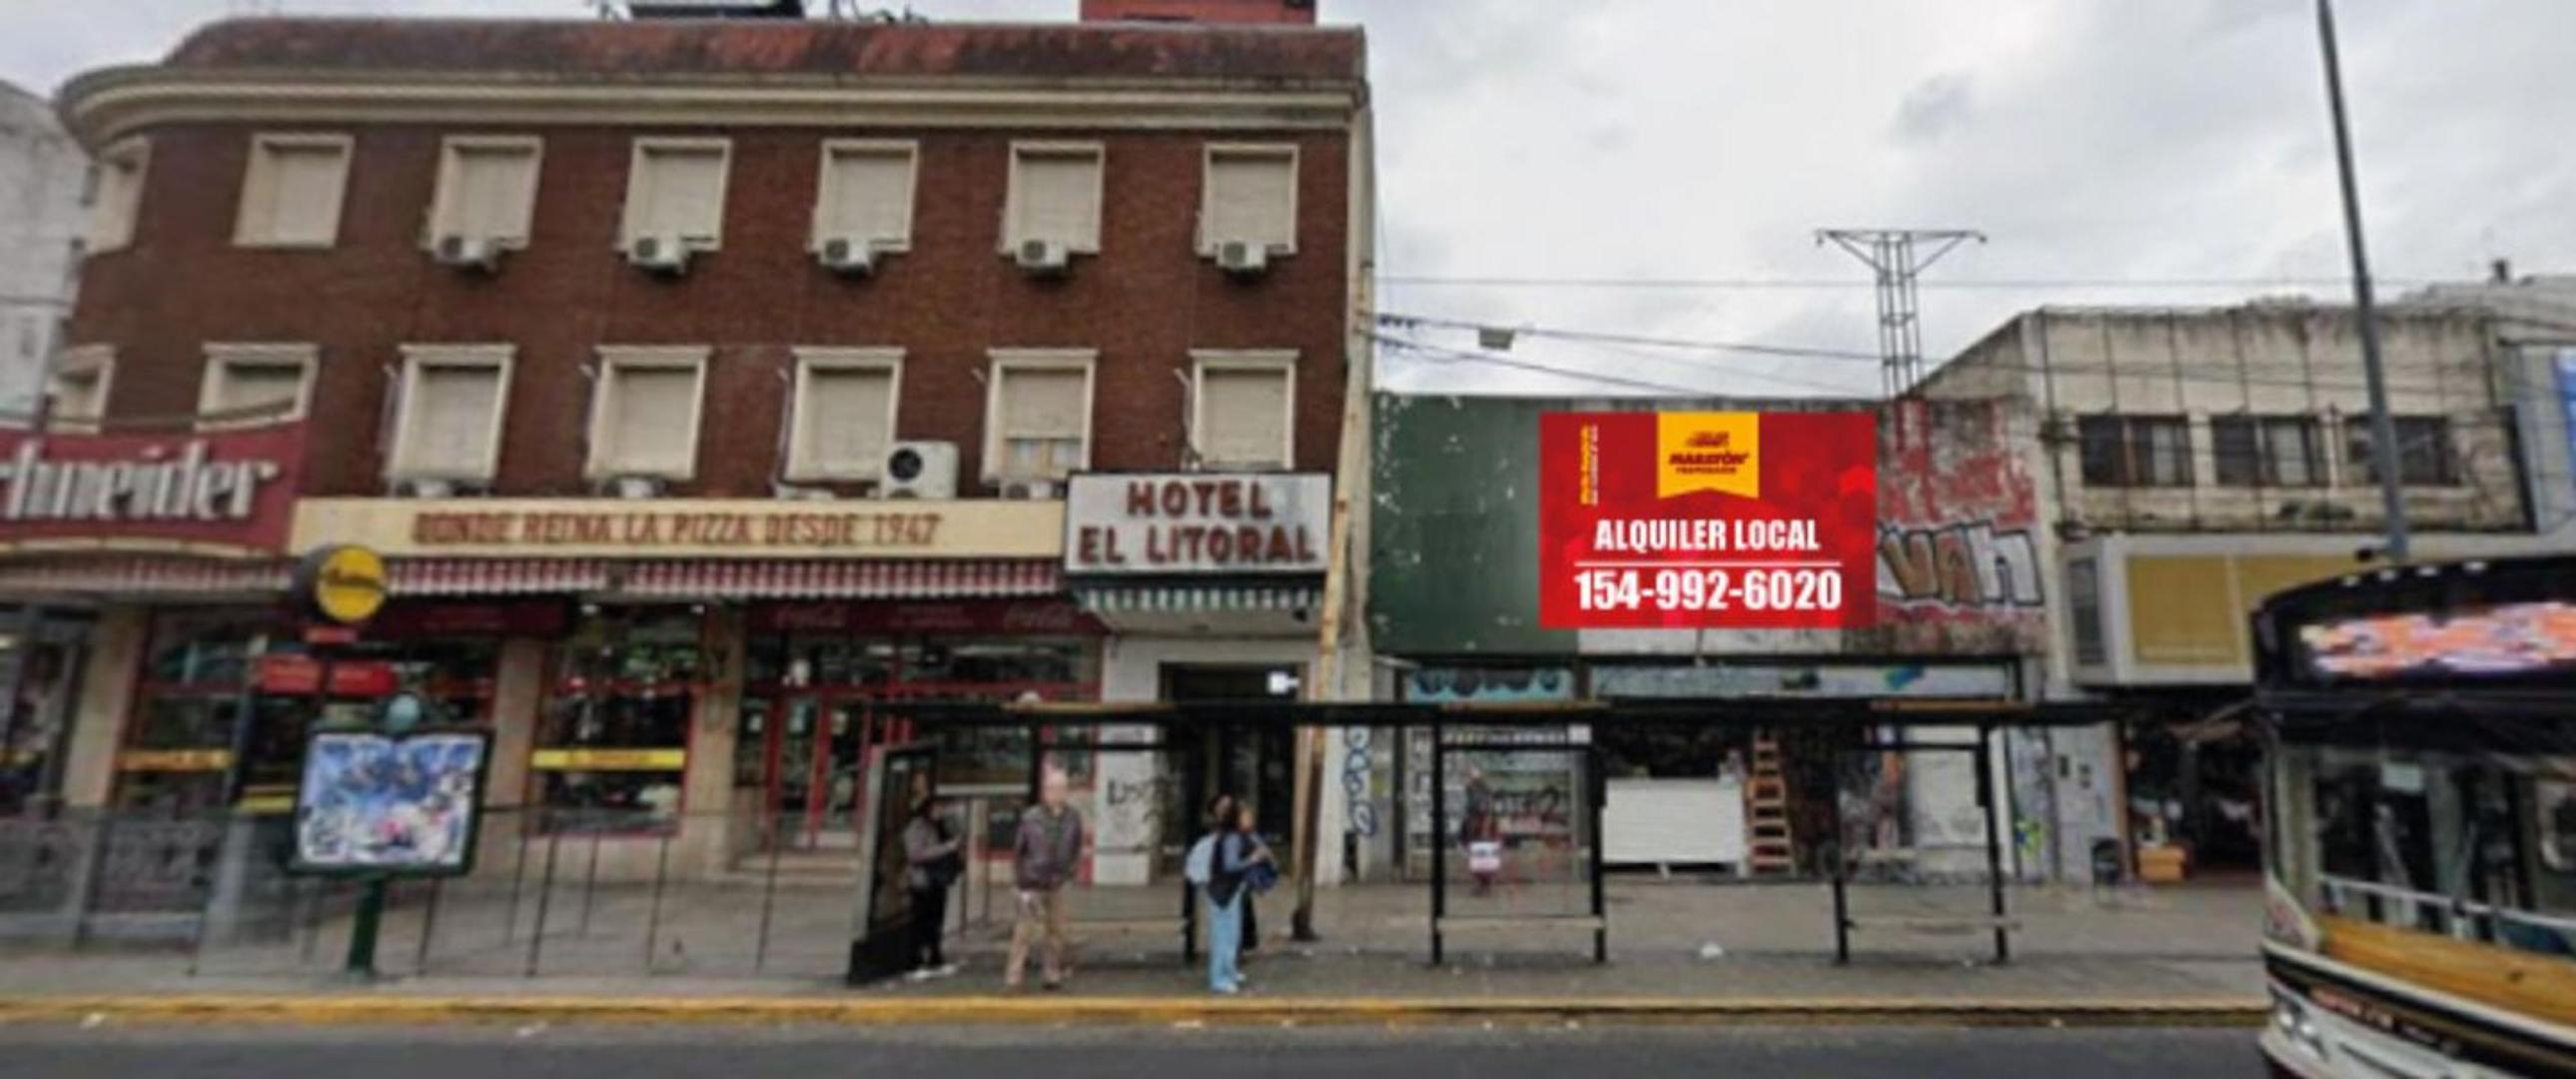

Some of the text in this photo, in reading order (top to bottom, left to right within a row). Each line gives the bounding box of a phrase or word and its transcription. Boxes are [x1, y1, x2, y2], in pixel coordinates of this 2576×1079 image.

[0, 440, 279, 520] hneider
[1126, 481, 1273, 520] HOTEL
[525, 513, 617, 545] REINA
[623, 513, 664, 545] LA
[671, 513, 753, 545] PIZZA
[764, 513, 856, 546] DESDE
[873, 513, 942, 545] 1947
[1078, 525, 1315, 564] EL LITORAL
[1594, 519, 1820, 553] ALQUILER LOCAL
[1574, 569, 1842, 610] 154-992-6020
